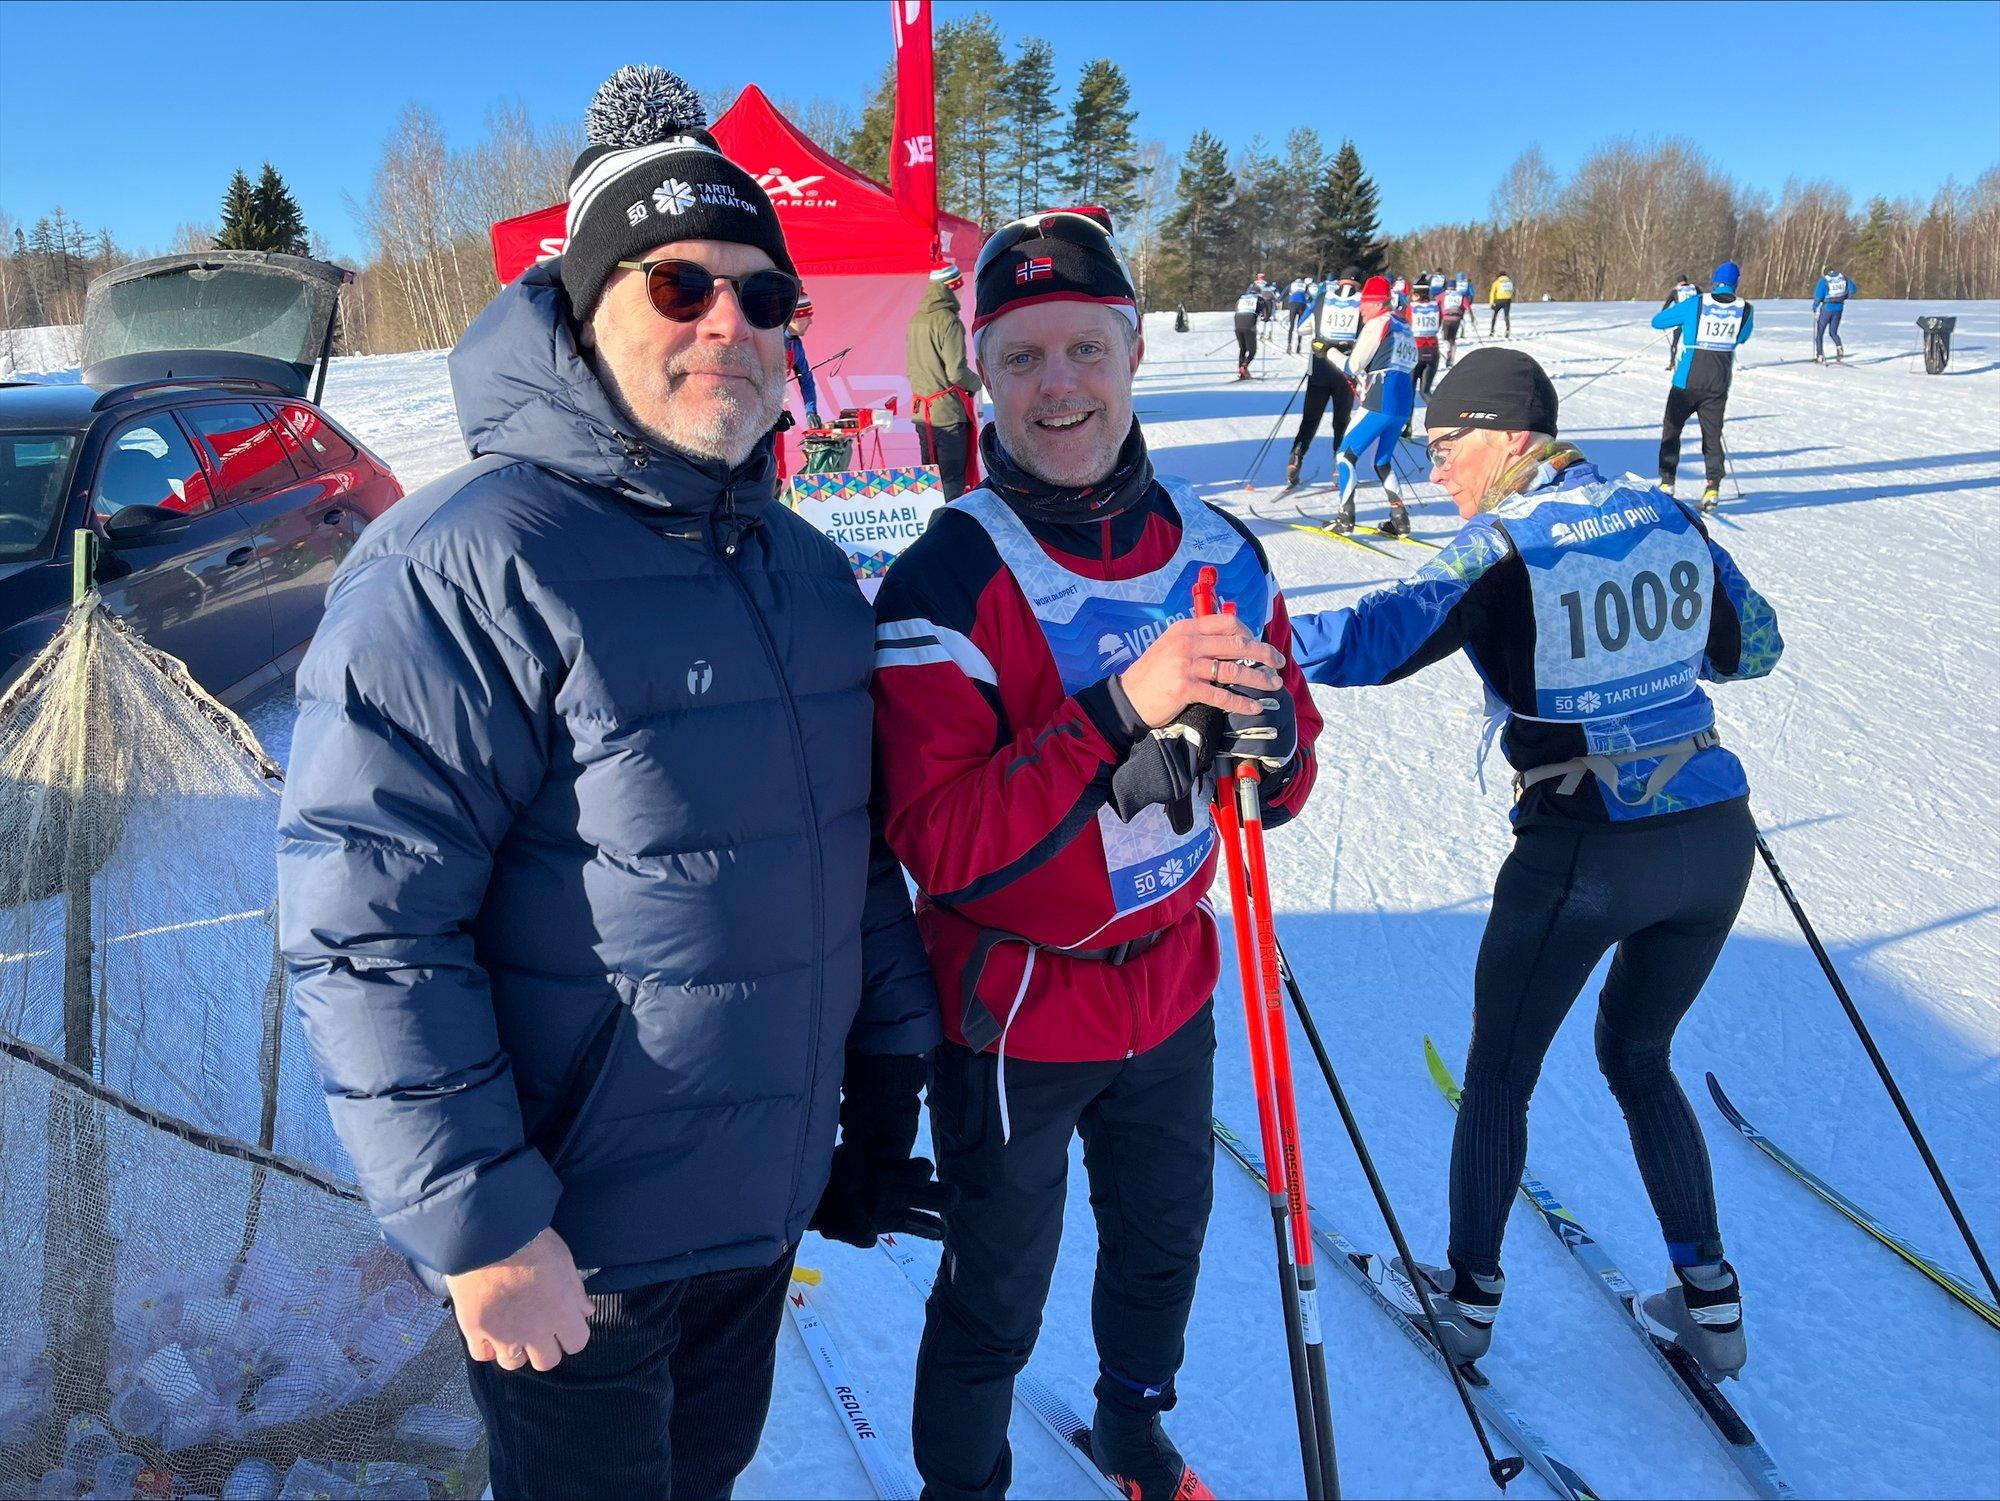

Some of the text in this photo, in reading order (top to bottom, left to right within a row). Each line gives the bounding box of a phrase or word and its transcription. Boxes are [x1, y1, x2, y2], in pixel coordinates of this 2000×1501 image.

[696, 183, 736, 197] TARTU
[627, 203, 648, 225] 50
[699, 193, 759, 216] MARATON
[1326, 314, 1355, 328] 4137
[1706, 321, 1736, 338] 1374
[831, 507, 918, 527] SUUSAABI
[1571, 505, 1661, 542] VALGA PUU
[825, 522, 926, 543] SKISERVICE
[1033, 585, 1078, 608] WORLDLOPPET
[1560, 560, 1703, 660] 1008
[1555, 666, 1698, 711] 50 TARTU MARATO
[1134, 874, 1156, 896] 50
[803, 1321, 819, 1330] 207
[835, 1385, 877, 1440] REDLINE
